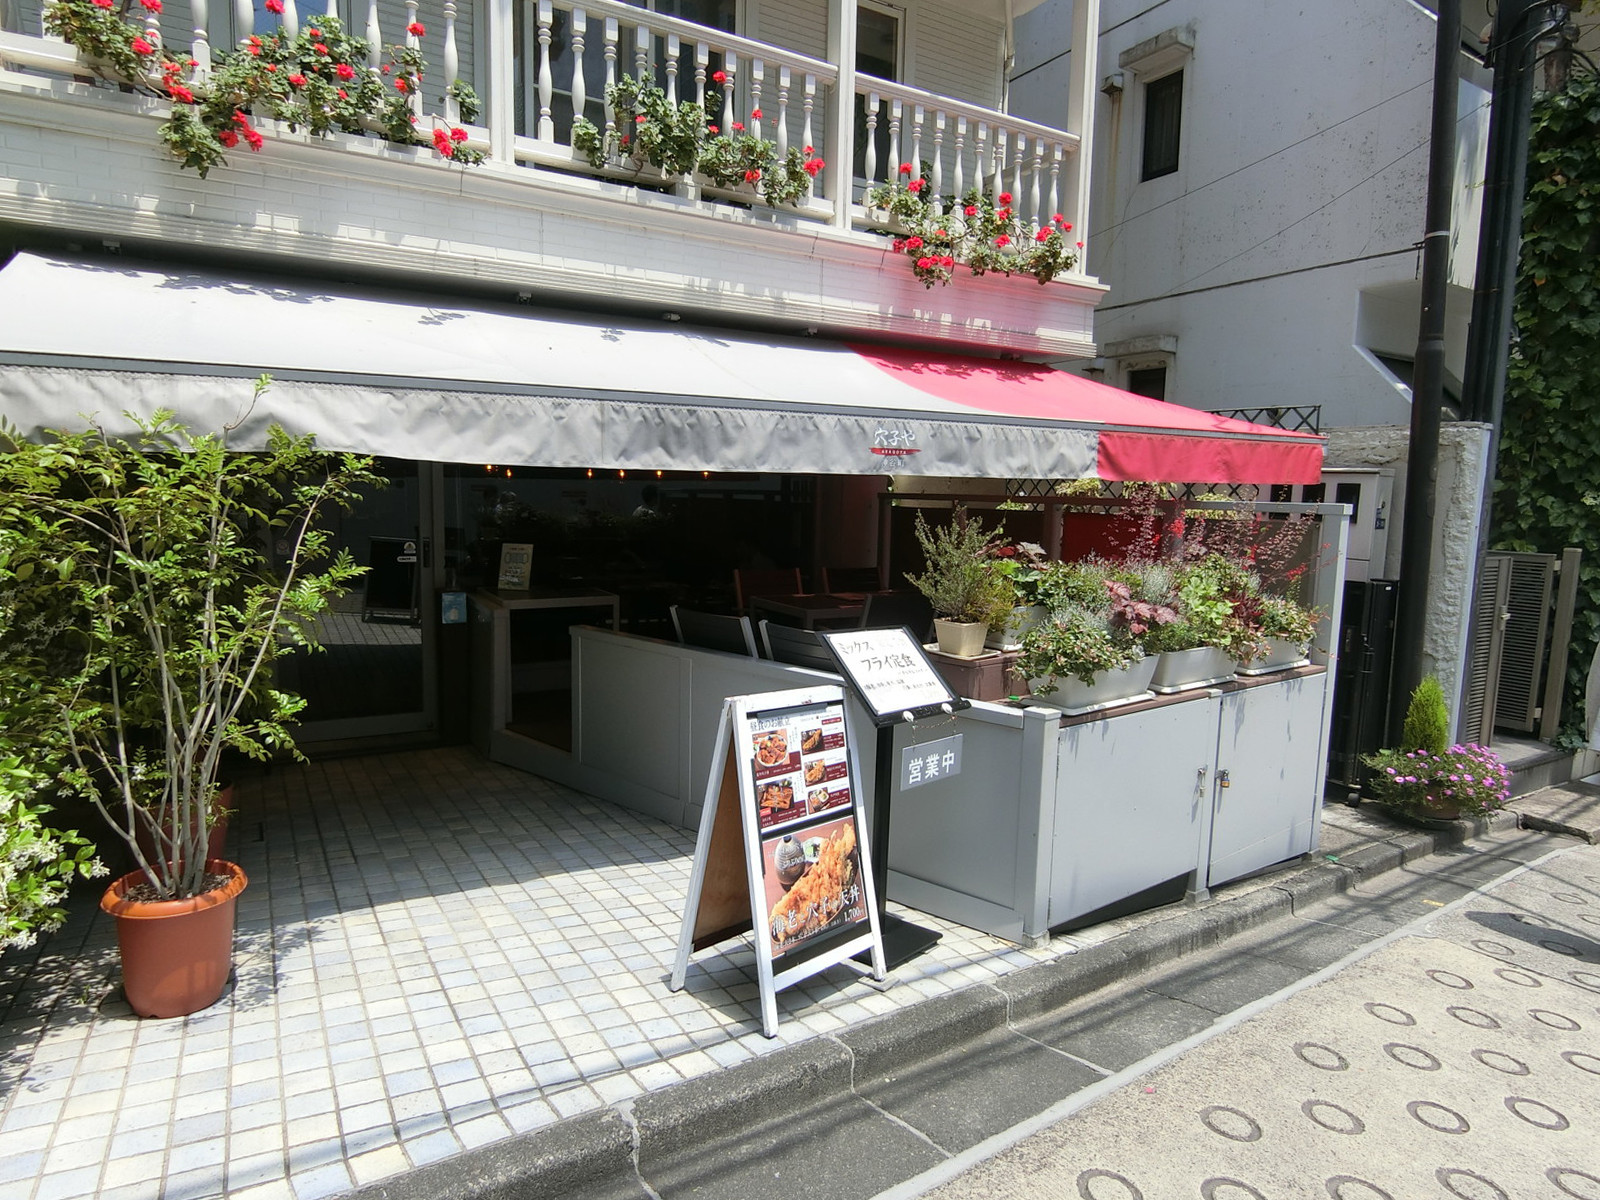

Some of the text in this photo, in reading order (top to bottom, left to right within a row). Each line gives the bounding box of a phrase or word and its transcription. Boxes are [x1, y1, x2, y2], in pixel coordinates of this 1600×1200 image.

[874, 427, 916, 447] 穴子や
[860, 652, 917, 672] フライ定食
[908, 749, 955, 785] 営業中
